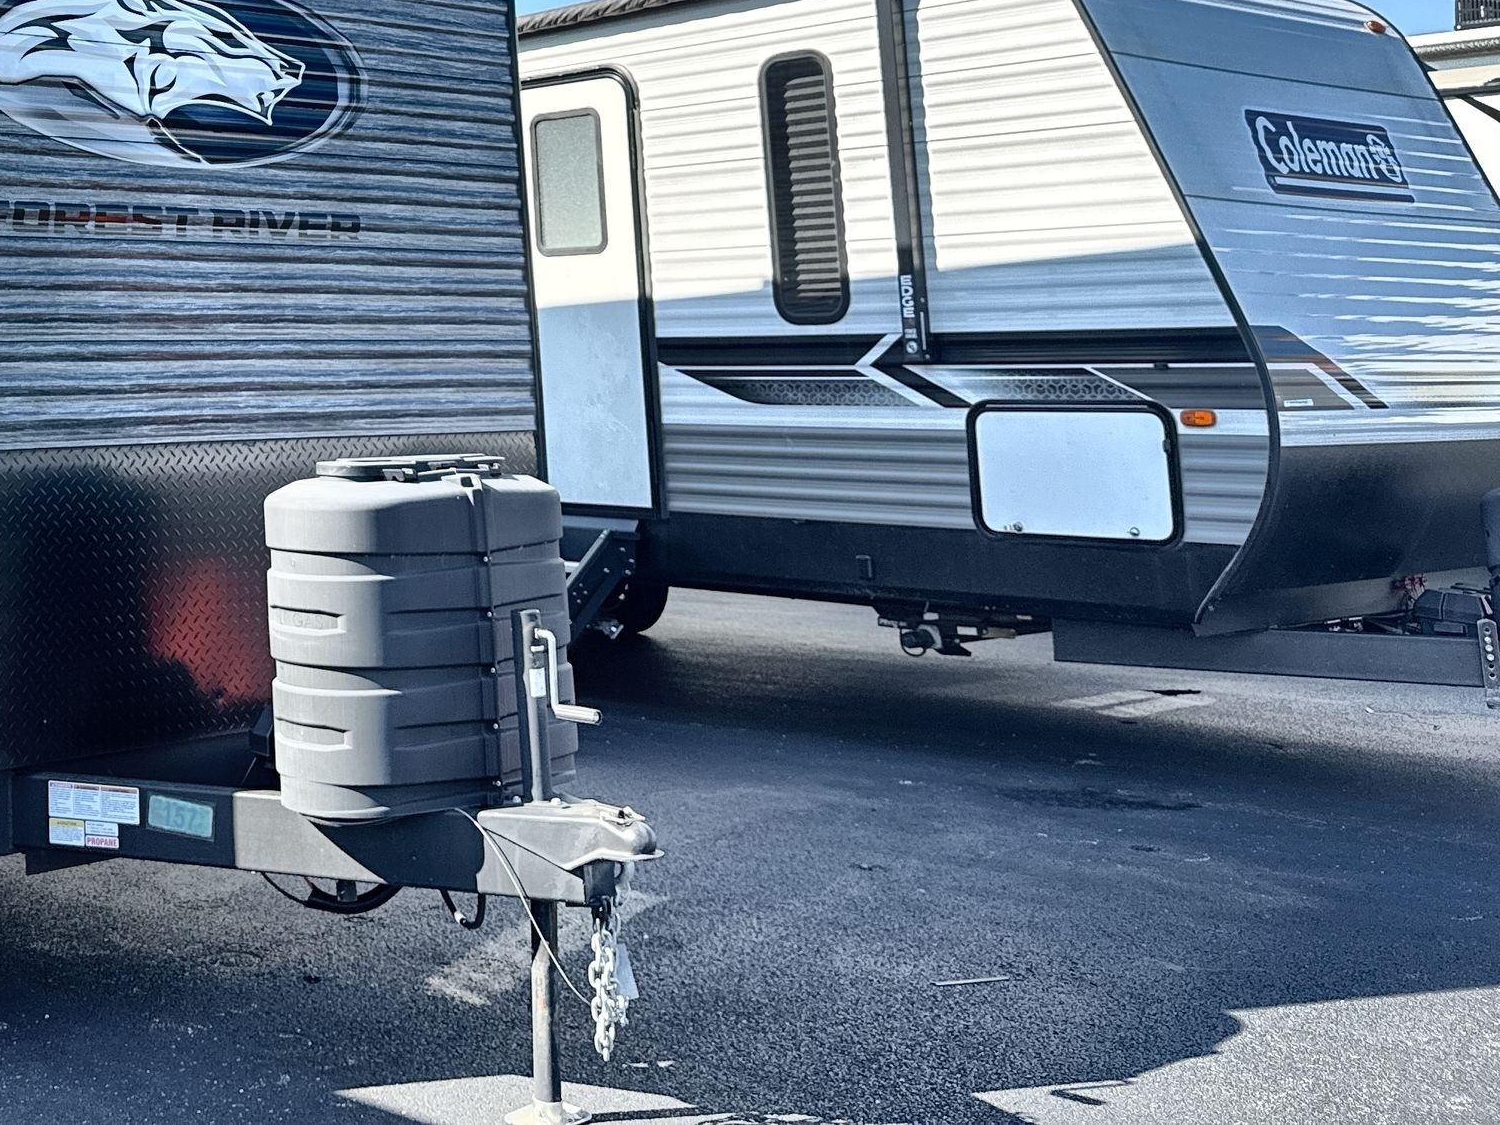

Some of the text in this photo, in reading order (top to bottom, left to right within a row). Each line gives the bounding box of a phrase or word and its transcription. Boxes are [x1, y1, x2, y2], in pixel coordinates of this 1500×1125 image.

[1255, 115, 1380, 180] Coleman
[211, 208, 362, 240] RIVER
[900, 274, 916, 318] EDGE
[86, 836, 117, 847] PROPANE
